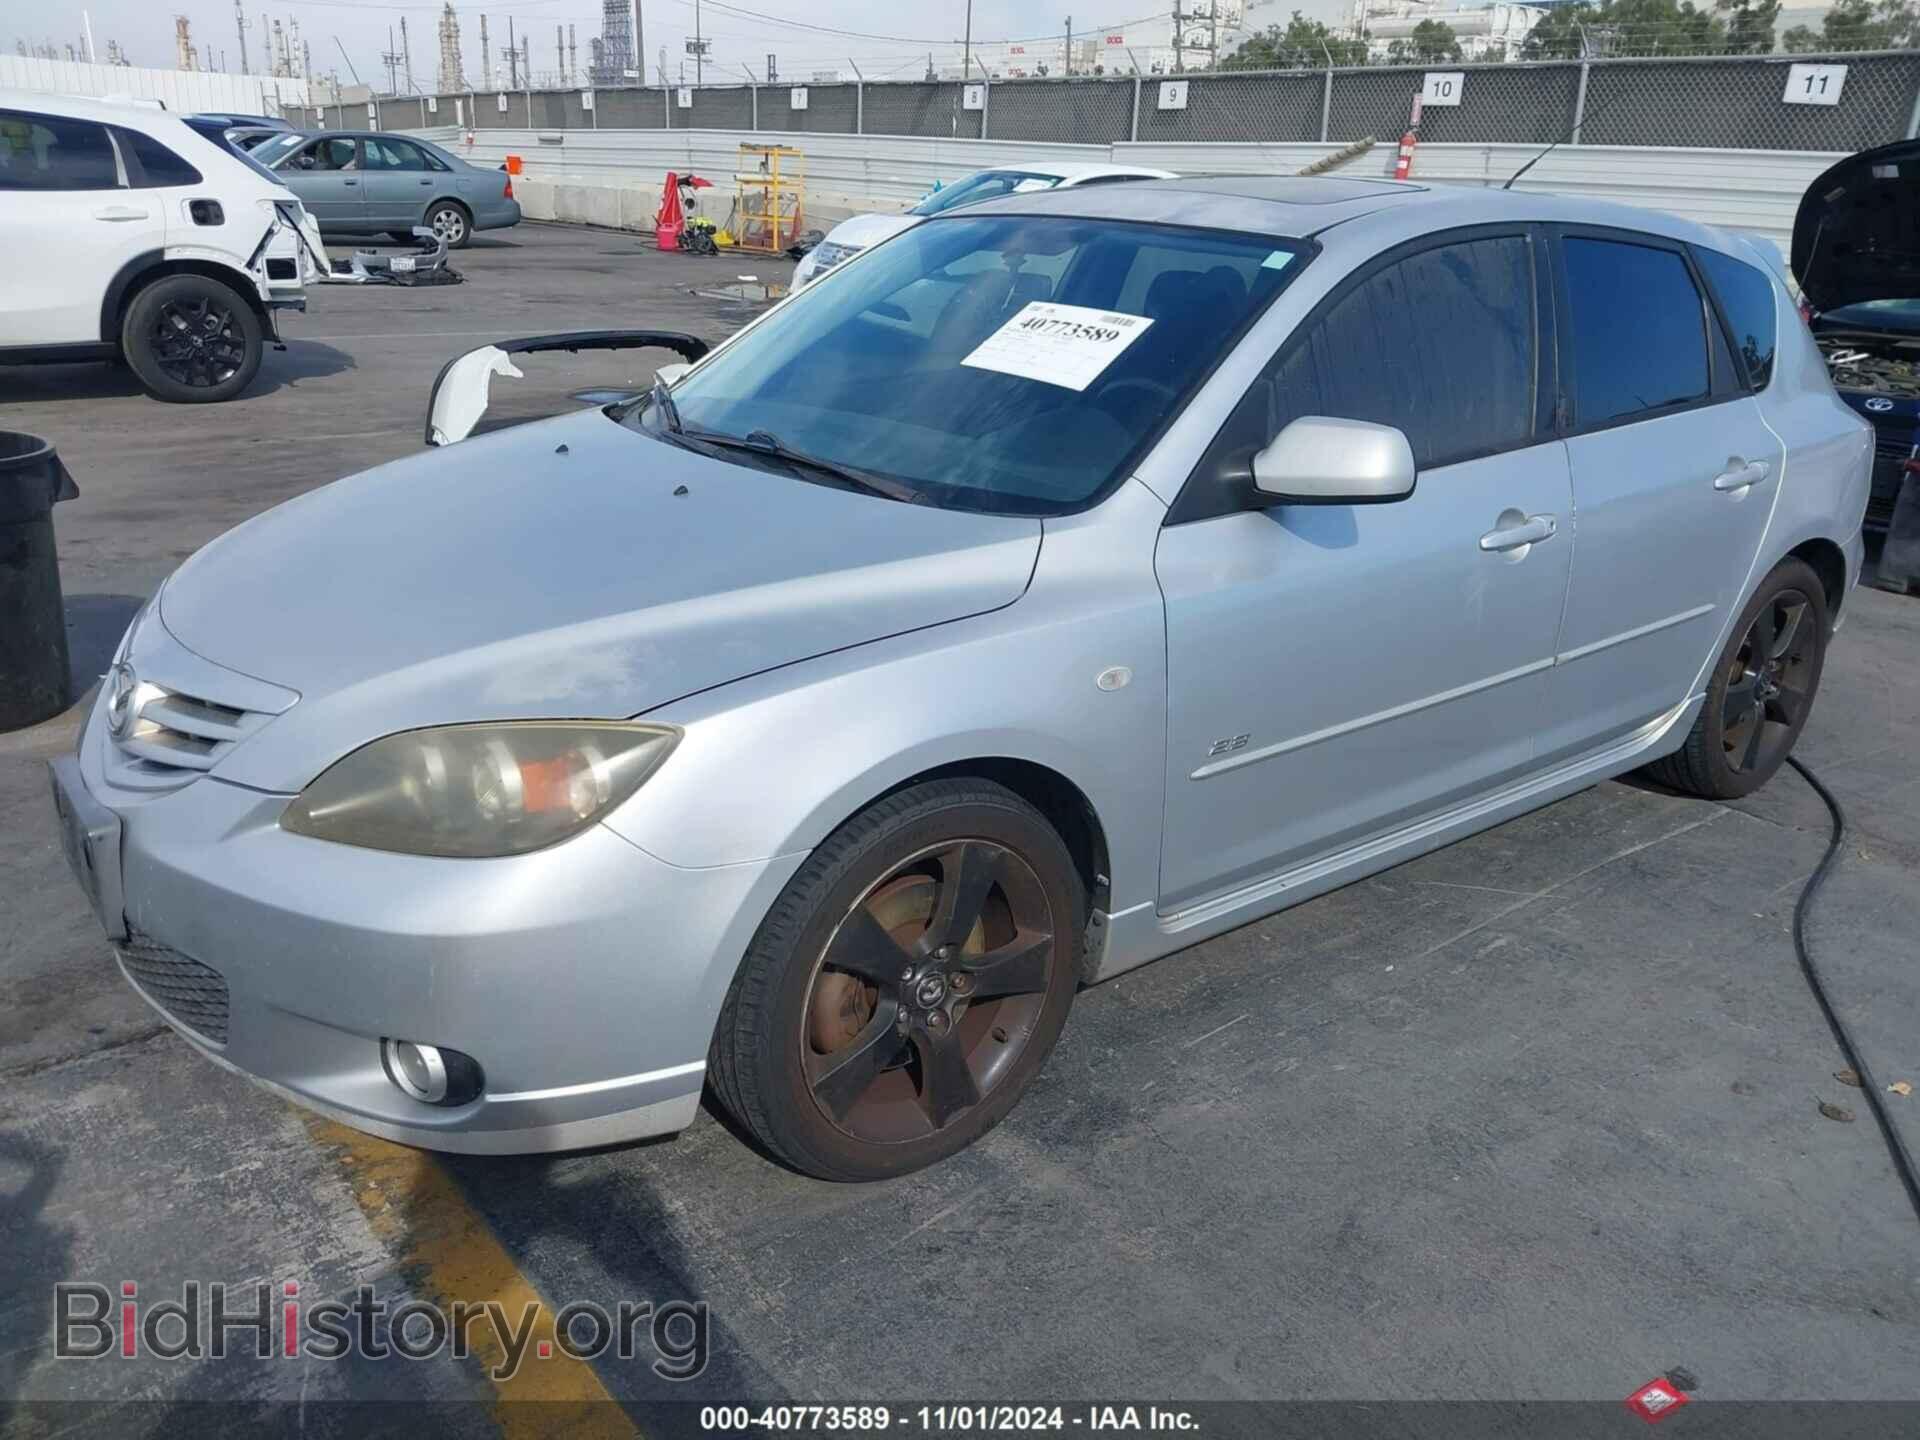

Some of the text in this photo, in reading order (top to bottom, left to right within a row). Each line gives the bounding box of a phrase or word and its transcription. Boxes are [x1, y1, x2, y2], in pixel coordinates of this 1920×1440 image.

[1433, 80, 1452, 97] 10
[1805, 74, 1828, 95] 11
[1169, 88, 1177, 102] 9
[1020, 316, 1120, 343] 40773589
